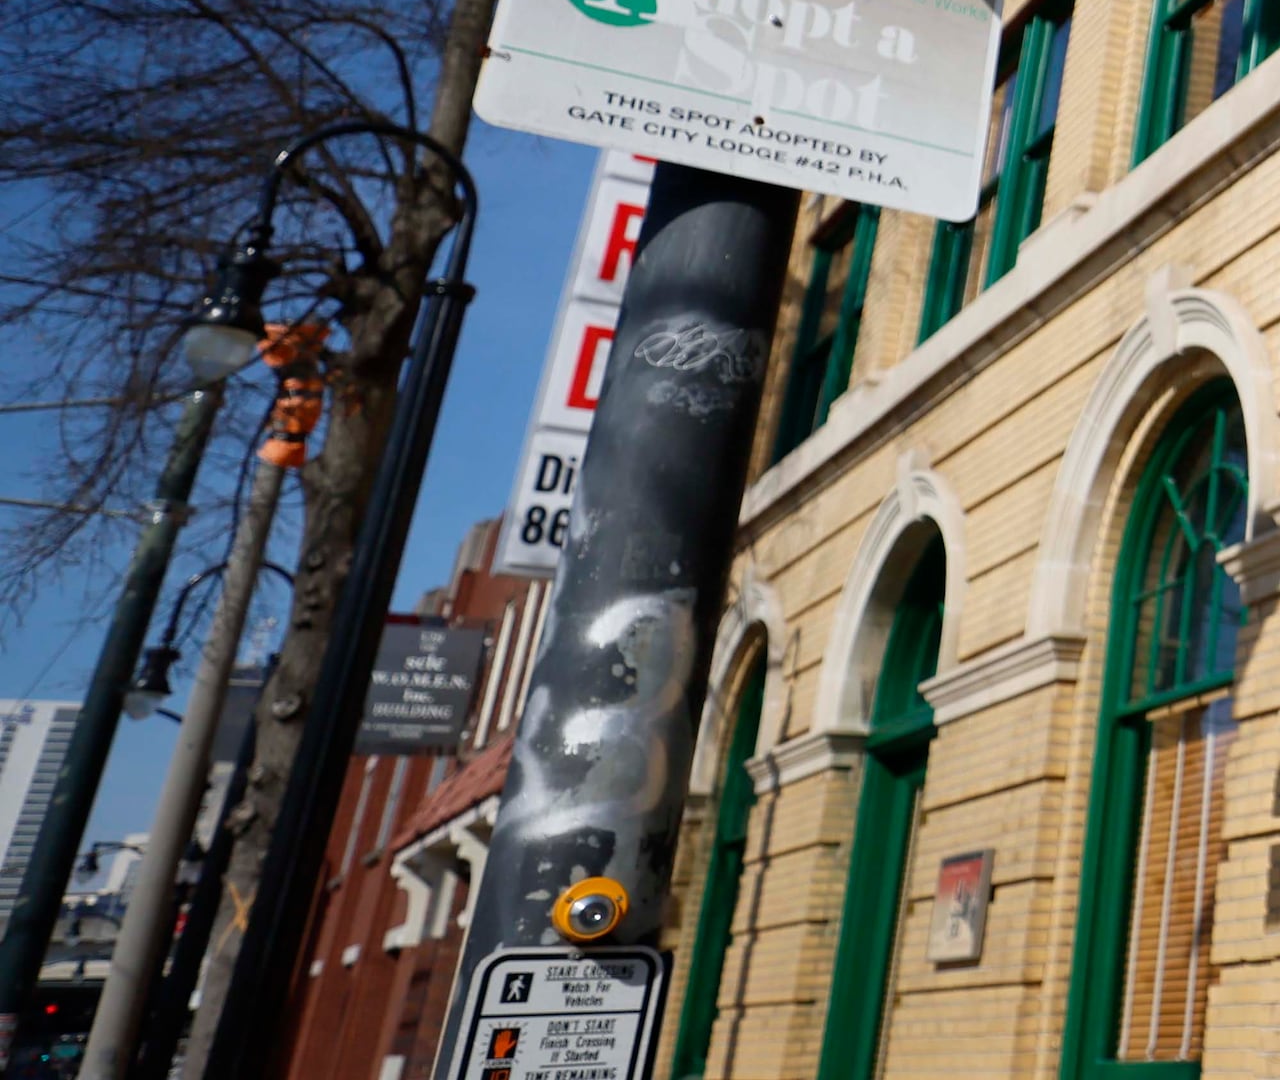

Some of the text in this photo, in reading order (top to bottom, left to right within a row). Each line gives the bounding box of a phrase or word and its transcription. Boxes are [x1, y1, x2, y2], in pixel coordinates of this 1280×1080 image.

[876, 25, 919, 64] a
[674, 14, 889, 129] Spot
[603, 91, 889, 166] THIS SPOT ADOPTED BY
[567, 105, 634, 131] GATE
[643, 122, 699, 144] CITY
[705, 136, 788, 164] LODGE
[795, 155, 841, 175] #42
[546, 966, 579, 978] START
[565, 996, 604, 1007] Vehicles
[548, 1019, 616, 1033] DON'T START
[539, 1035, 616, 1050] Finish Crossing
[564, 1050, 599, 1062] Started
[554, 1067, 617, 1080] REMAINING
